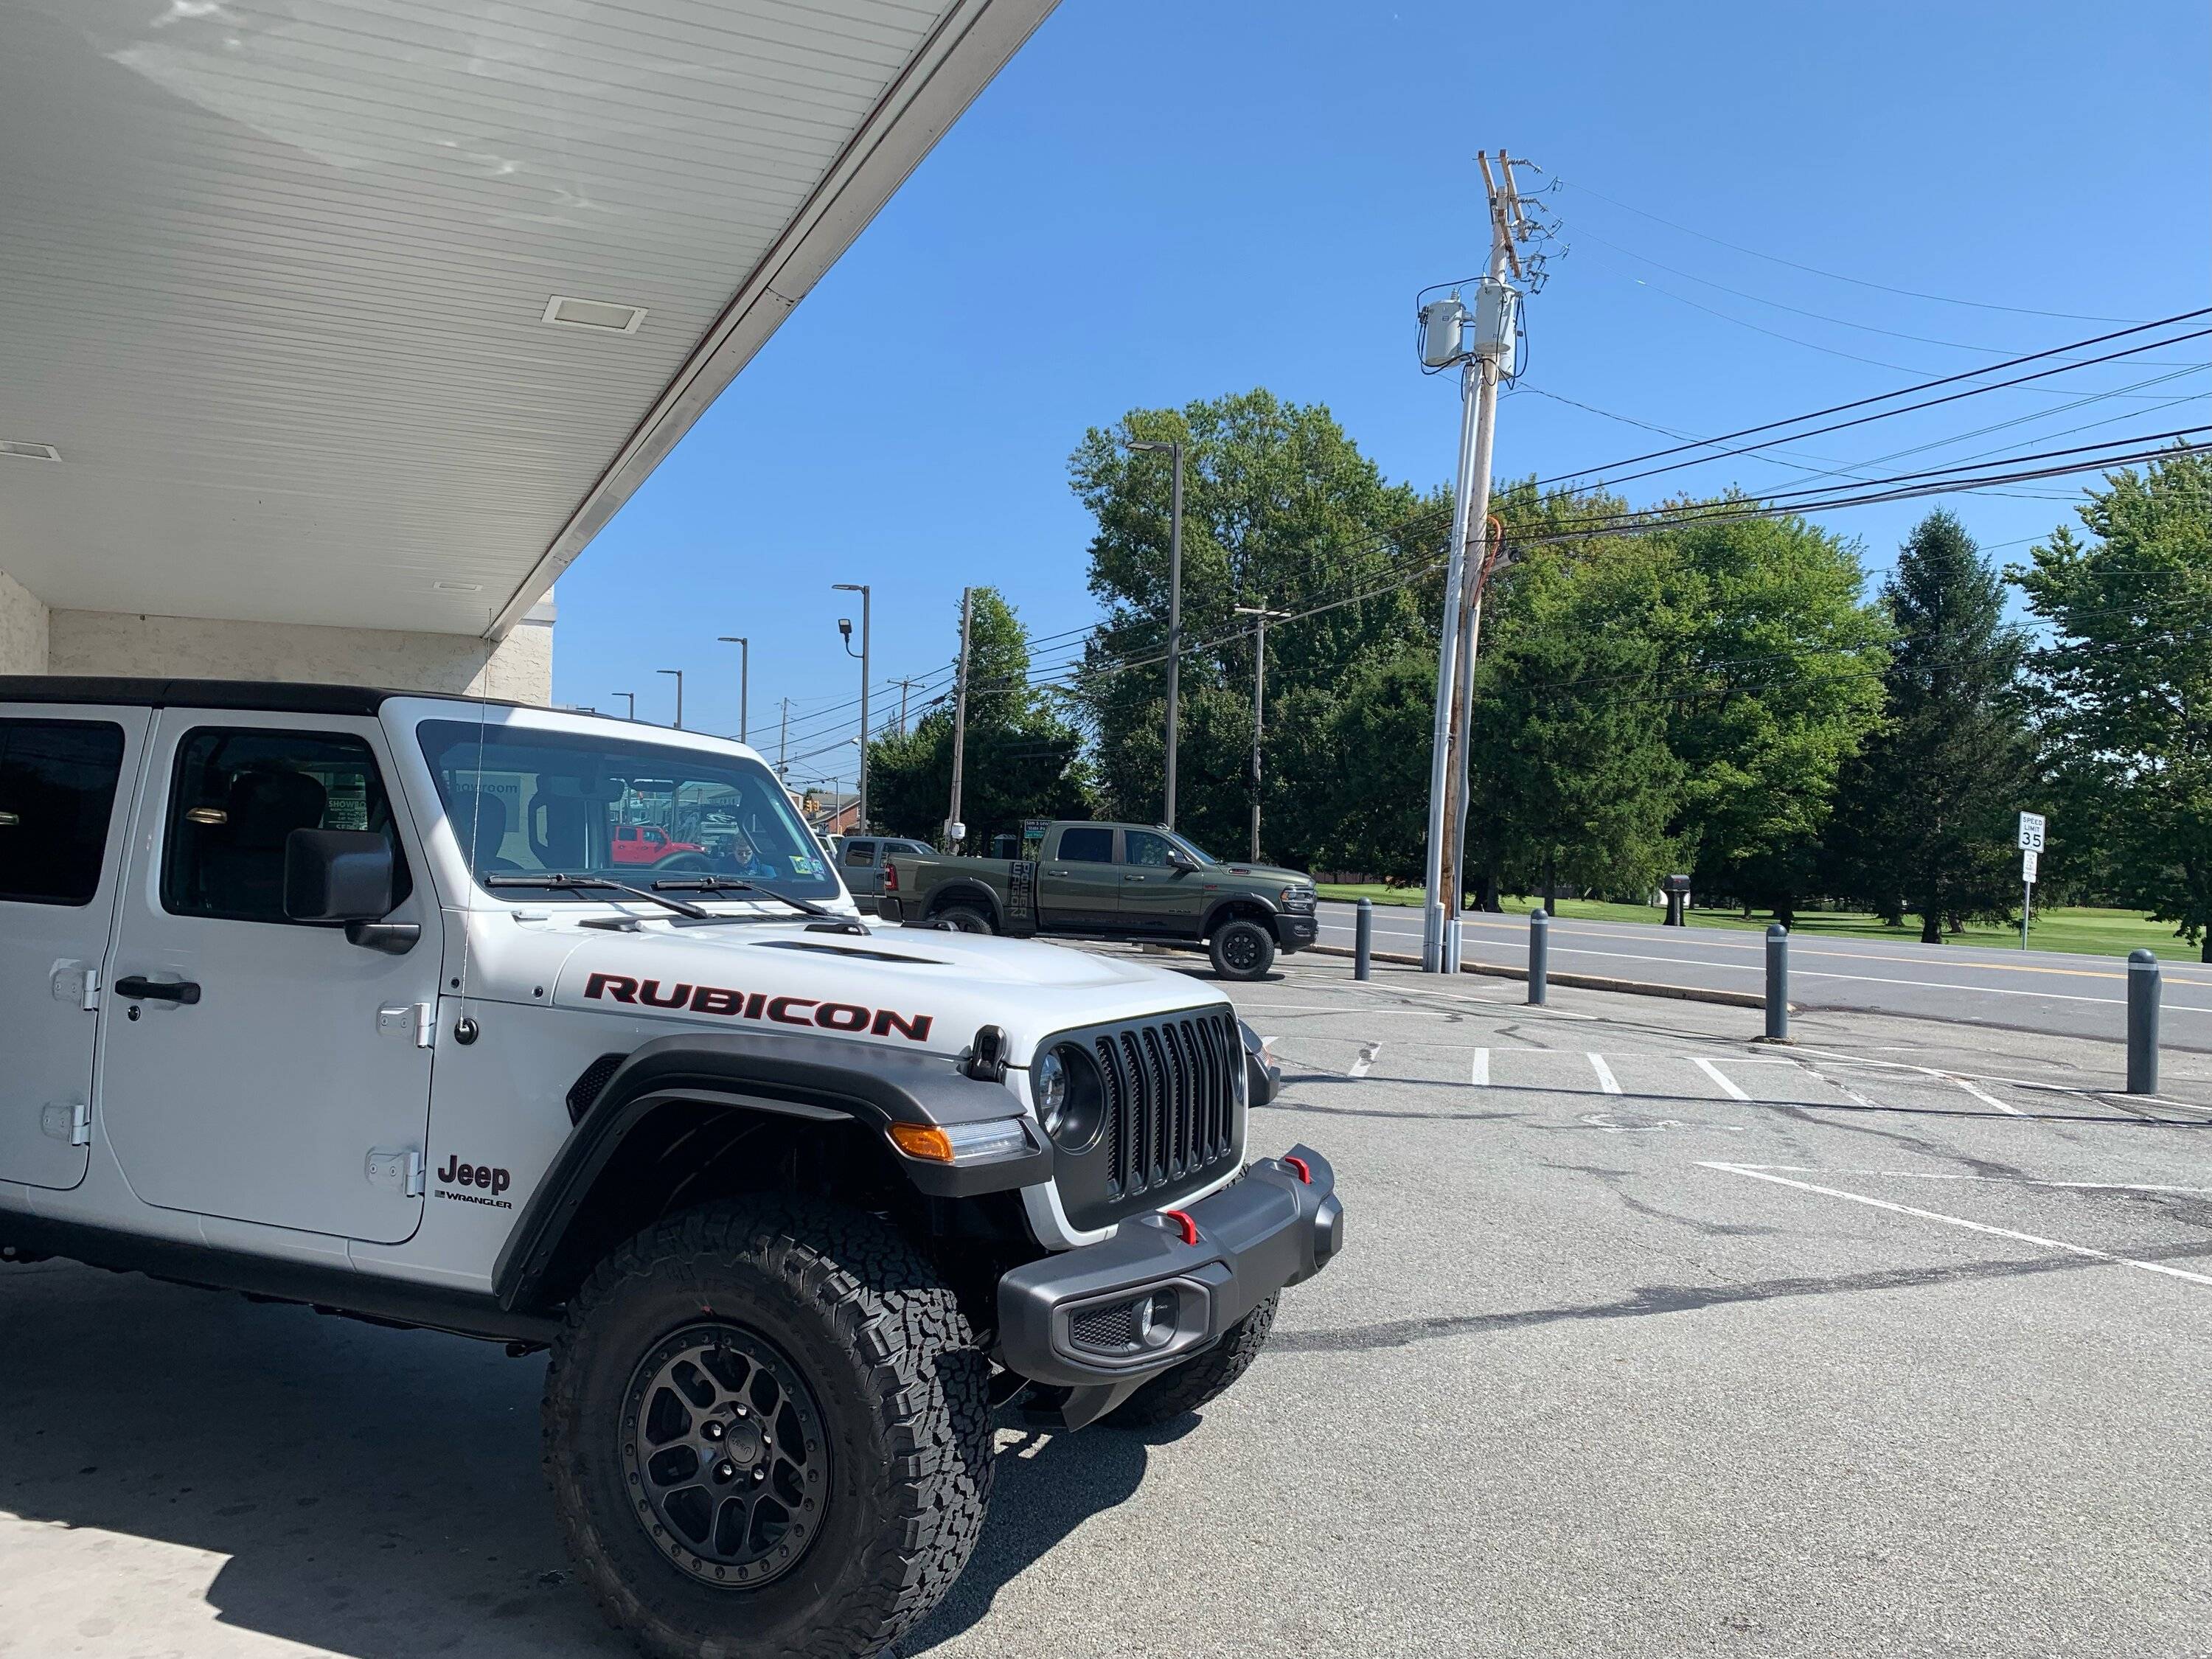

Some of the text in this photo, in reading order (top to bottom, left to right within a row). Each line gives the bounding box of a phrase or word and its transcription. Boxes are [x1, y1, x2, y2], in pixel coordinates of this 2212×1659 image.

[449, 782, 518, 794] howroom
[329, 800, 366, 808] SHOWRO
[2023, 816, 2043, 826] SPEED
[2022, 832, 2041, 847] 35
[1011, 862, 1022, 917] WAGON
[1020, 863, 1030, 919] POWER
[584, 973, 933, 1042] RUBICON
[438, 1155, 510, 1196] Jeep
[446, 1192, 512, 1209] WRANGLER
